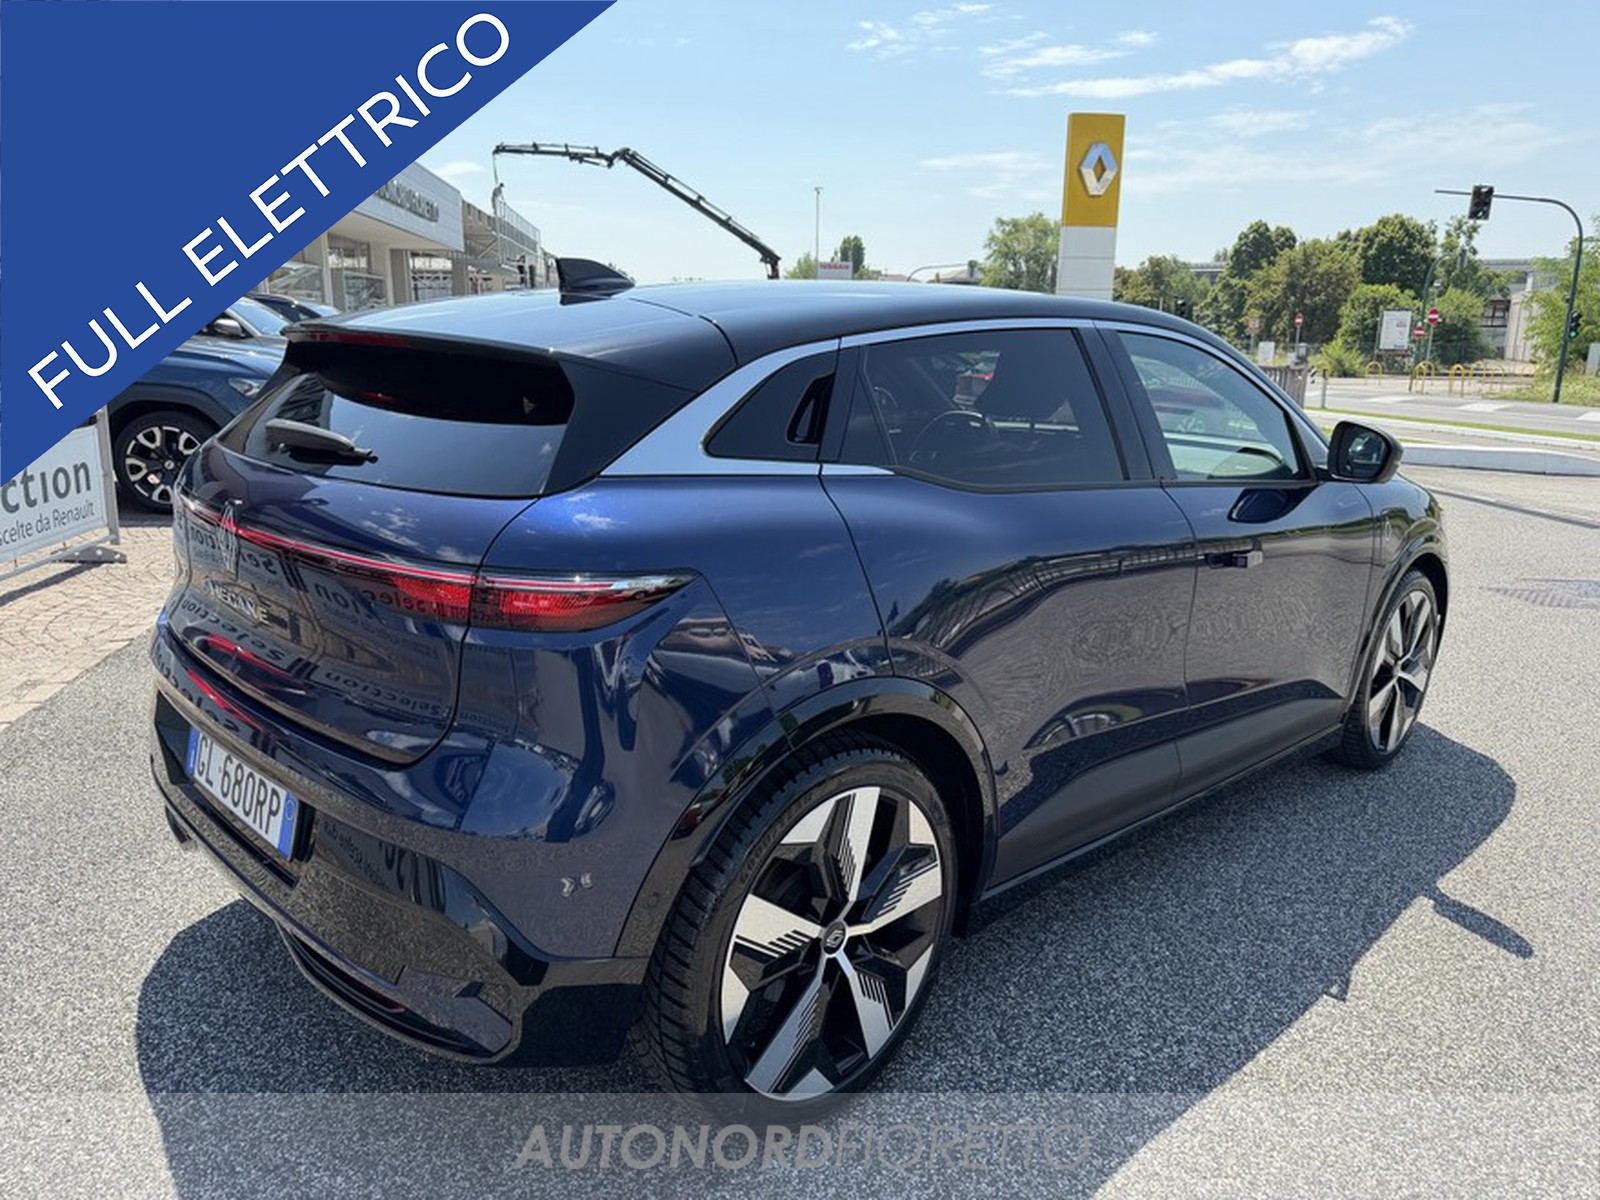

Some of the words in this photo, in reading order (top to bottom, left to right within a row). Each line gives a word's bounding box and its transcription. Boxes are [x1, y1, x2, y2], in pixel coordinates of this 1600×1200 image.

[35, 513, 51, 534] da
[52, 499, 95, 529] Renault
[197, 735, 214, 788] GL
[220, 754, 281, 835] 680RP
